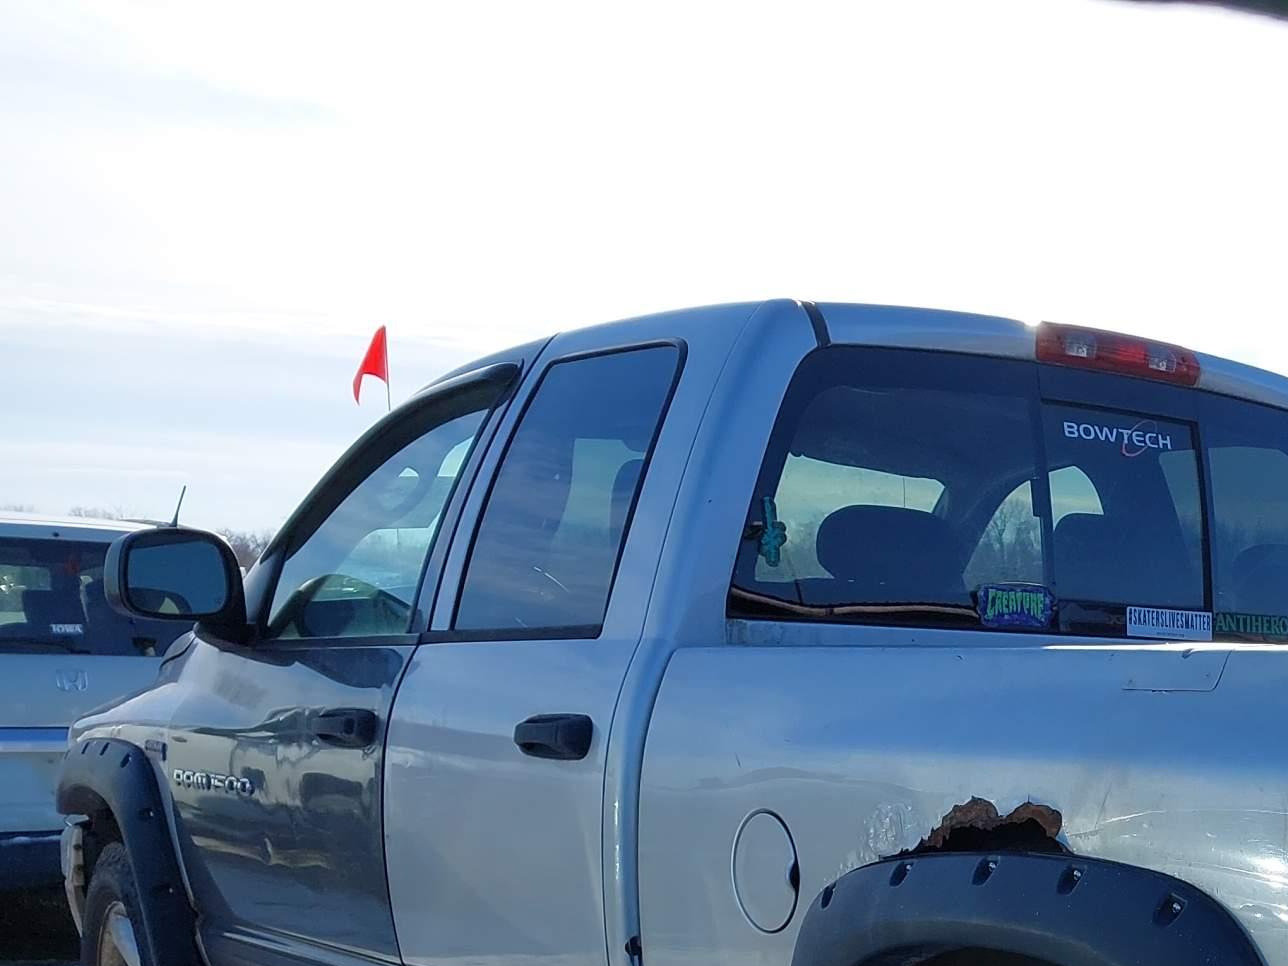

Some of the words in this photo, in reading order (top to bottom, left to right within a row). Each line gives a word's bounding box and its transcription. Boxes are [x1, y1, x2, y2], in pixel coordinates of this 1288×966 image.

[1063, 421, 1172, 450] BOWTECH
[984, 588, 1047, 622] CREATURE
[49, 623, 83, 634] IOWA
[1128, 608, 1211, 632] #SKATERSLIVESMATTER
